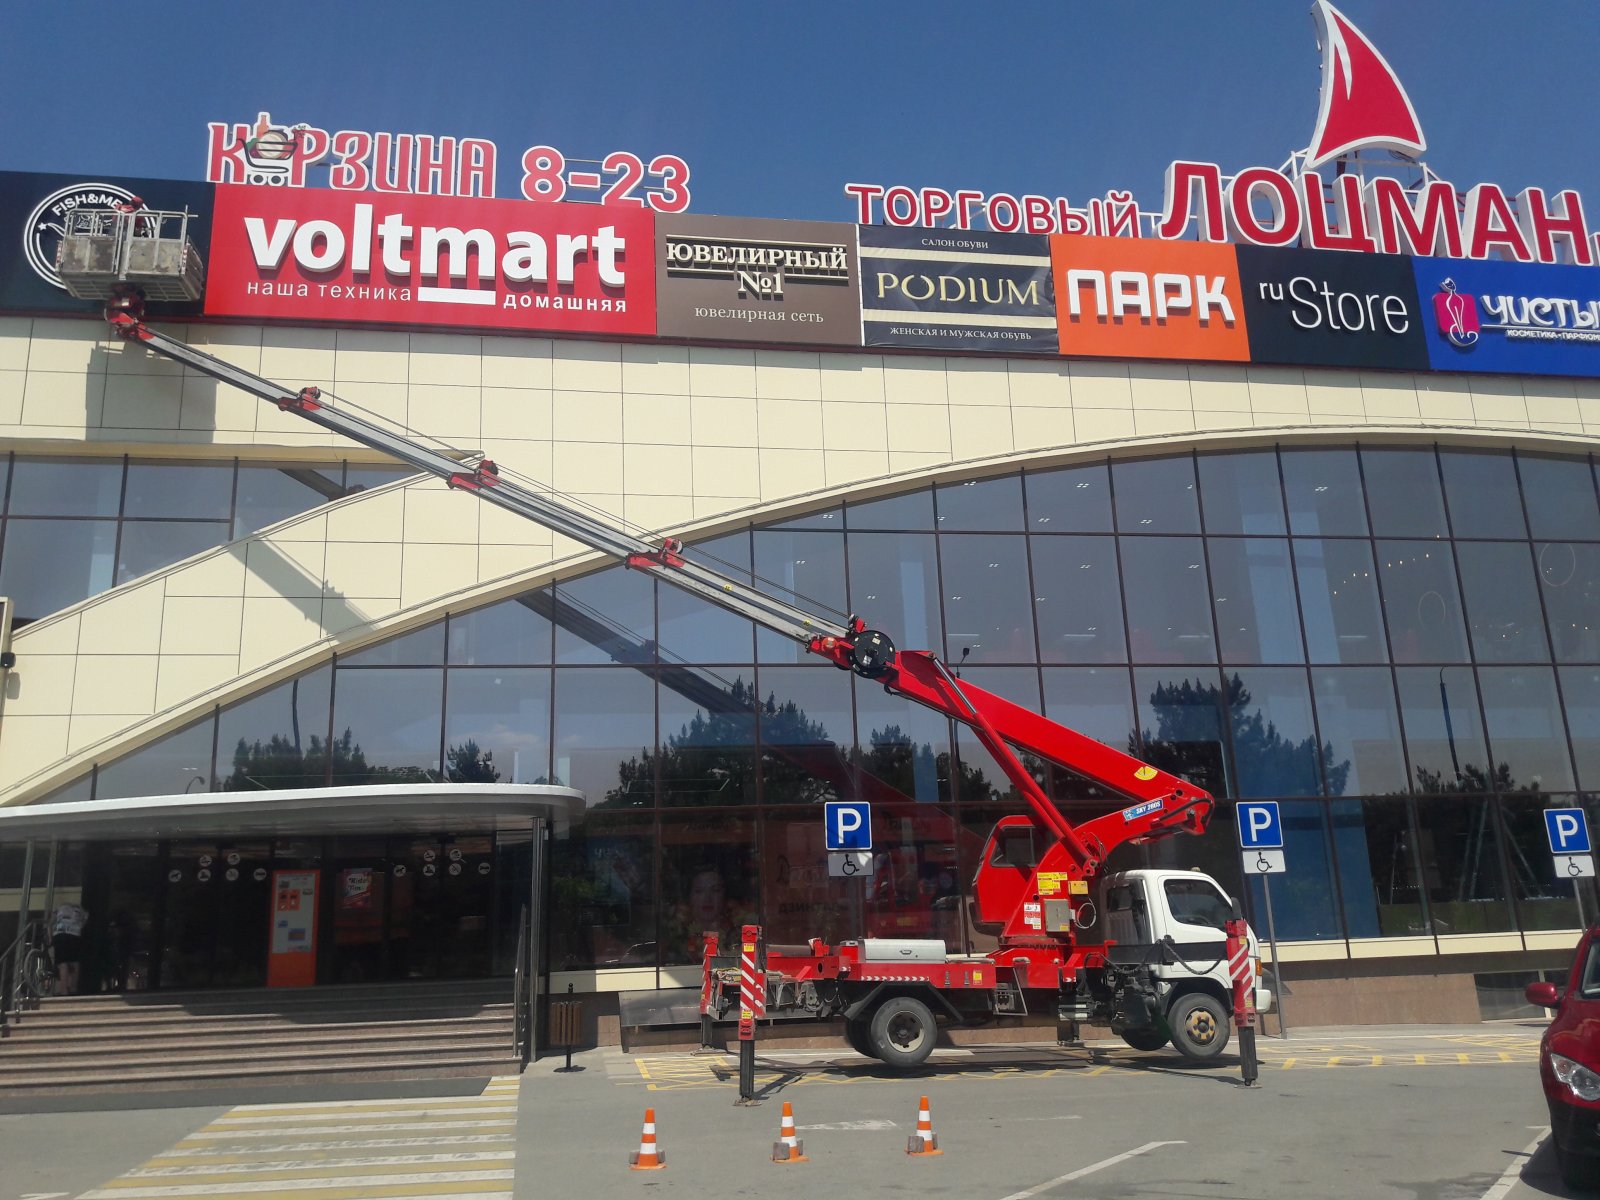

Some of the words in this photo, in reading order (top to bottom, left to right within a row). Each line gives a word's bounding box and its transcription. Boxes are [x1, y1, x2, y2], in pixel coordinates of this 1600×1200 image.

[521, 145, 690, 213] 8-23
[51, 193, 124, 217] FISH&ME
[844, 182, 1142, 239] ТОРГОВЫЙ
[1157, 159, 1594, 266] ЛОЦМАН
[244, 202, 626, 288] voltmart
[667, 241, 848, 270] ЮВЕЛИРНЫЙ
[921, 238, 956, 247] САЛОН
[956, 239, 989, 249] ОБУВИ
[247, 281, 309, 298] наша
[318, 283, 412, 302] техника
[503, 292, 627, 314] домашняя
[876, 272, 1040, 306] PODIUM
[1066, 268, 1236, 324] ПАРК
[1259, 282, 1284, 301] ru
[1289, 276, 1409, 334] Store
[694, 306, 786, 324] ювелирная
[791, 310, 825, 324] сеть
[1481, 295, 1600, 328] ЧИСТЫ
[890, 327, 938, 337] ЖЕНСКАЯ
[940, 329, 948, 337] И
[949, 330, 1000, 340] МУЖСКАЯ
[1000, 332, 1032, 341] ОБУВЬ
[837, 807, 862, 844] P
[1248, 807, 1272, 842] P
[1555, 814, 1578, 847] P
